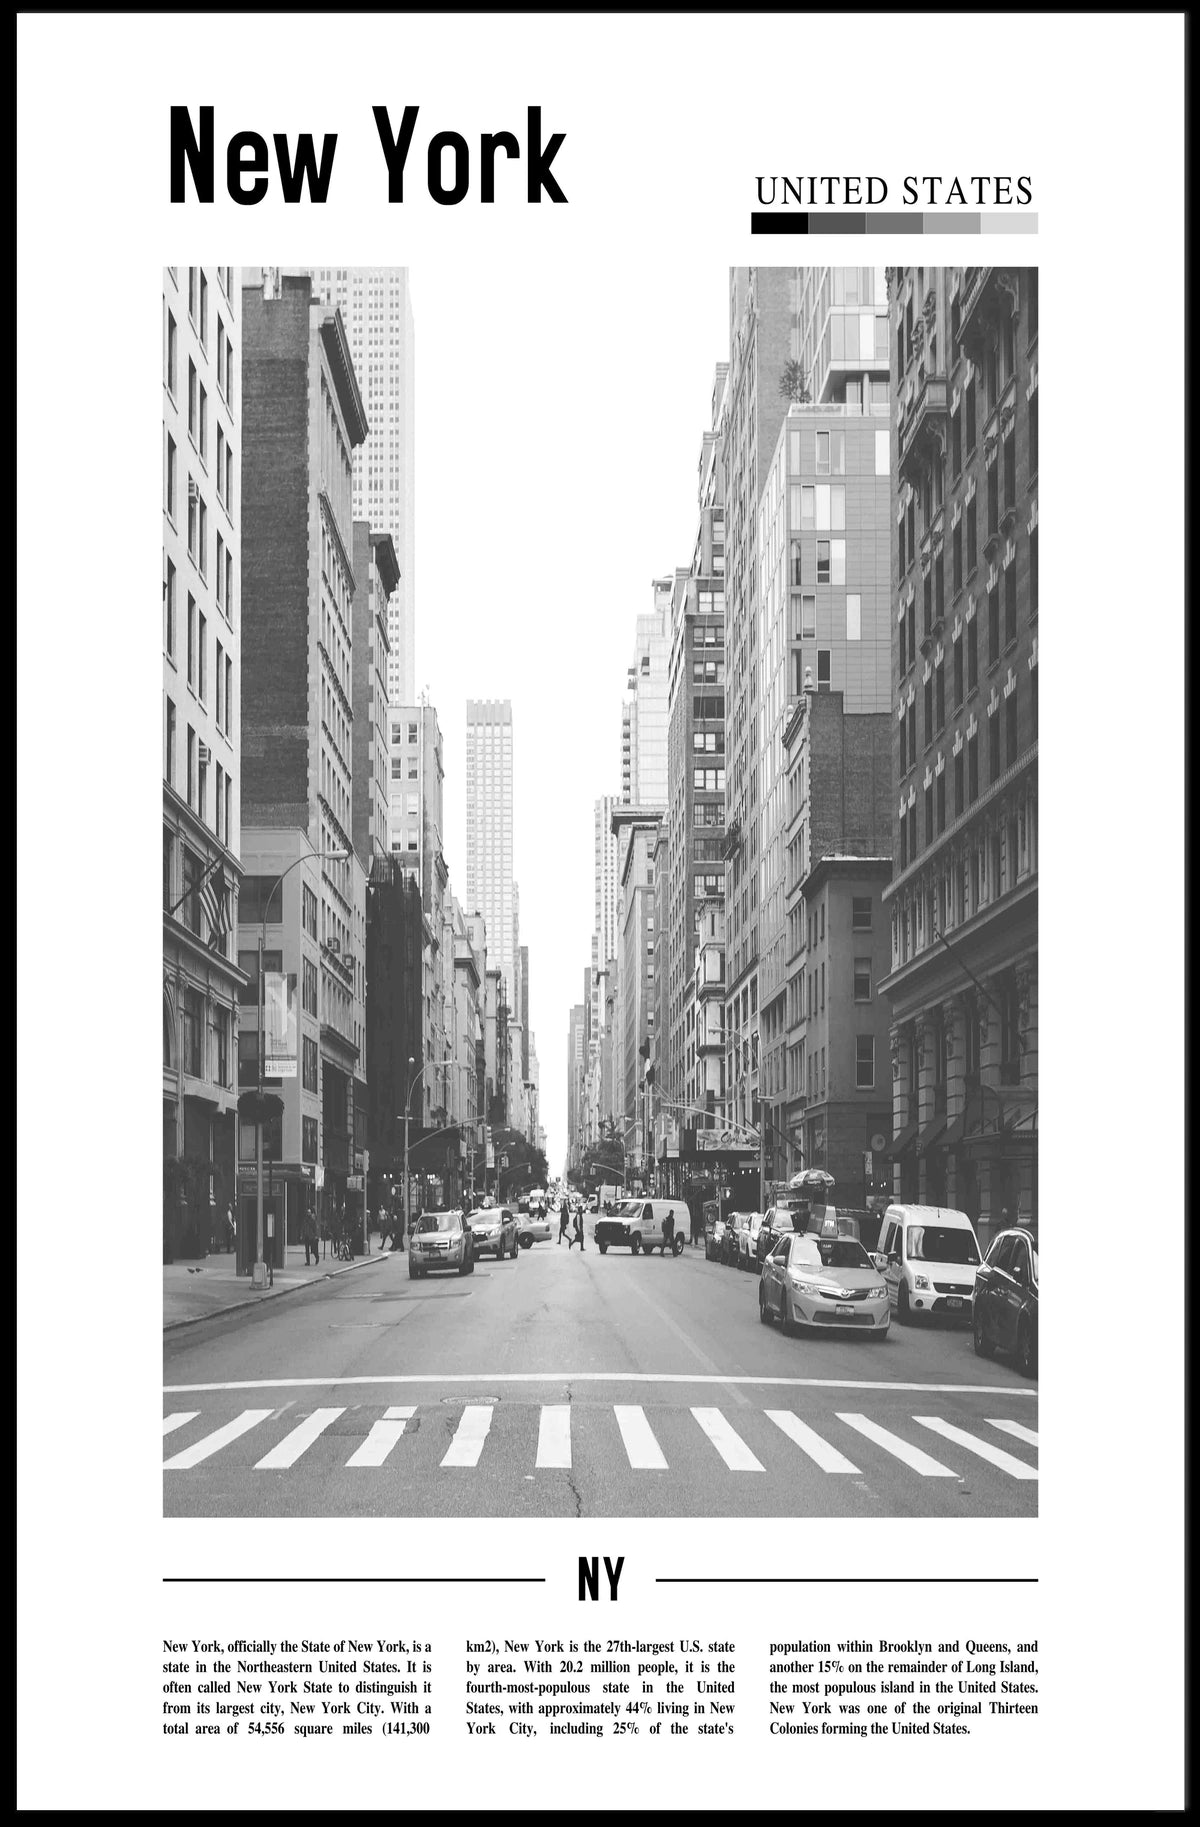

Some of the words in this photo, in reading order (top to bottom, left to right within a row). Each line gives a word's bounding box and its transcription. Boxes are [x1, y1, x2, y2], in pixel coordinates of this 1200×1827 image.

[170, 106, 338, 205] New
[372, 106, 569, 205] York
[755, 177, 888, 205] UNITED
[903, 176, 1032, 205] STATES
[579, 1557, 625, 1601] NY
[163, 1640, 188, 1652] New
[192, 1640, 224, 1654] York,
[228, 1640, 277, 1655] officially
[280, 1640, 298, 1652] the
[302, 1640, 330, 1652] State
[334, 1640, 346, 1652] of
[348, 1640, 373, 1652] New
[377, 1640, 409, 1654] York,
[413, 1640, 421, 1652] is
[425, 1644, 431, 1652] a
[467, 1640, 499, 1654] km2),
[505, 1640, 529, 1652] New
[535, 1640, 564, 1652] York
[570, 1640, 578, 1652] is
[584, 1640, 601, 1652] the
[607, 1640, 674, 1655] 27th-largest
[680, 1640, 703, 1652] U.S.
[708, 1641, 735, 1652] state
[770, 1640, 830, 1655] population
[837, 1640, 873, 1652] within
[879, 1640, 932, 1655] Brooklyn
[938, 1640, 959, 1652] and
[966, 1640, 1011, 1655] Queens,
[1017, 1640, 1038, 1652] and
[163, 1662, 189, 1673] state
[196, 1661, 206, 1672] in
[213, 1661, 231, 1672] the
[237, 1661, 312, 1673] Northeastern
[319, 1661, 357, 1673] United
[363, 1660, 400, 1673] States.
[407, 1661, 416, 1672] It
[423, 1661, 431, 1672] is
[466, 1661, 480, 1676] by
[488, 1664, 516, 1673] area.
[524, 1661, 552, 1672] With
[560, 1660, 583, 1673] 20.2
[591, 1661, 630, 1673] million
[638, 1661, 678, 1676] people,
[686, 1661, 693, 1672] it
[701, 1661, 710, 1673] is
[717, 1661, 735, 1672] the
[770, 1661, 814, 1673] another
[819, 1661, 844, 1672] 15%
[848, 1664, 862, 1673] on
[866, 1661, 884, 1673] the
[888, 1661, 947, 1673] remainder
[951, 1661, 963, 1673] of
[967, 1661, 996, 1676] Long
[1000, 1661, 1038, 1675] Island,
[163, 1681, 191, 1693] often
[198, 1681, 230, 1693] called
[237, 1681, 262, 1693] New
[268, 1681, 297, 1693] York
[304, 1681, 332, 1693] State
[339, 1682, 349, 1693] to
[356, 1681, 417, 1696] distinguish
[424, 1681, 431, 1693] it
[466, 1681, 590, 1696] fourth-most-populous
[603, 1682, 629, 1693] state
[643, 1681, 653, 1693] in
[666, 1681, 684, 1693] the
[697, 1681, 734, 1693] United
[770, 1681, 787, 1693] the
[792, 1682, 819, 1693] most
[825, 1681, 876, 1696] populous
[881, 1681, 914, 1693] island
[920, 1681, 930, 1693] in
[936, 1681, 953, 1693] the
[958, 1681, 996, 1693] United
[1001, 1681, 1038, 1693] States.
[163, 1702, 191, 1714] from
[197, 1702, 210, 1714] its
[216, 1702, 254, 1717] largest
[260, 1702, 284, 1717] city,
[291, 1702, 315, 1714] New
[322, 1702, 351, 1714] York
[357, 1702, 384, 1717] City.
[391, 1702, 419, 1714] With
[425, 1705, 431, 1714] a
[466, 1702, 503, 1716] States,
[509, 1702, 533, 1714] with
[538, 1702, 621, 1717] approximately
[626, 1702, 652, 1714] 44%
[657, 1702, 689, 1717] living
[694, 1702, 705, 1713] in
[710, 1702, 735, 1714] New
[770, 1702, 794, 1714] New
[802, 1702, 831, 1714] York
[839, 1705, 860, 1714] was
[867, 1705, 887, 1714] one
[894, 1702, 906, 1714] of
[913, 1702, 930, 1714] the
[938, 1702, 981, 1717] original
[989, 1702, 1038, 1714] Thirteen
[163, 1722, 188, 1734] total
[195, 1725, 220, 1734] area
[227, 1722, 239, 1734] of
[248, 1722, 284, 1736] 54,556
[294, 1725, 333, 1737] square
[343, 1722, 372, 1734] miles
[383, 1722, 430, 1736] (141,300
[467, 1722, 496, 1734] York
[509, 1722, 536, 1737] City,
[550, 1722, 603, 1737] including
[613, 1722, 639, 1734] 25%
[650, 1722, 661, 1734] of
[671, 1722, 688, 1734] the
[698, 1722, 733, 1734] state's
[770, 1722, 818, 1734] Colonies
[822, 1722, 867, 1737] forming
[871, 1722, 888, 1734] the
[892, 1722, 929, 1734] United
[933, 1722, 970, 1734] States.
